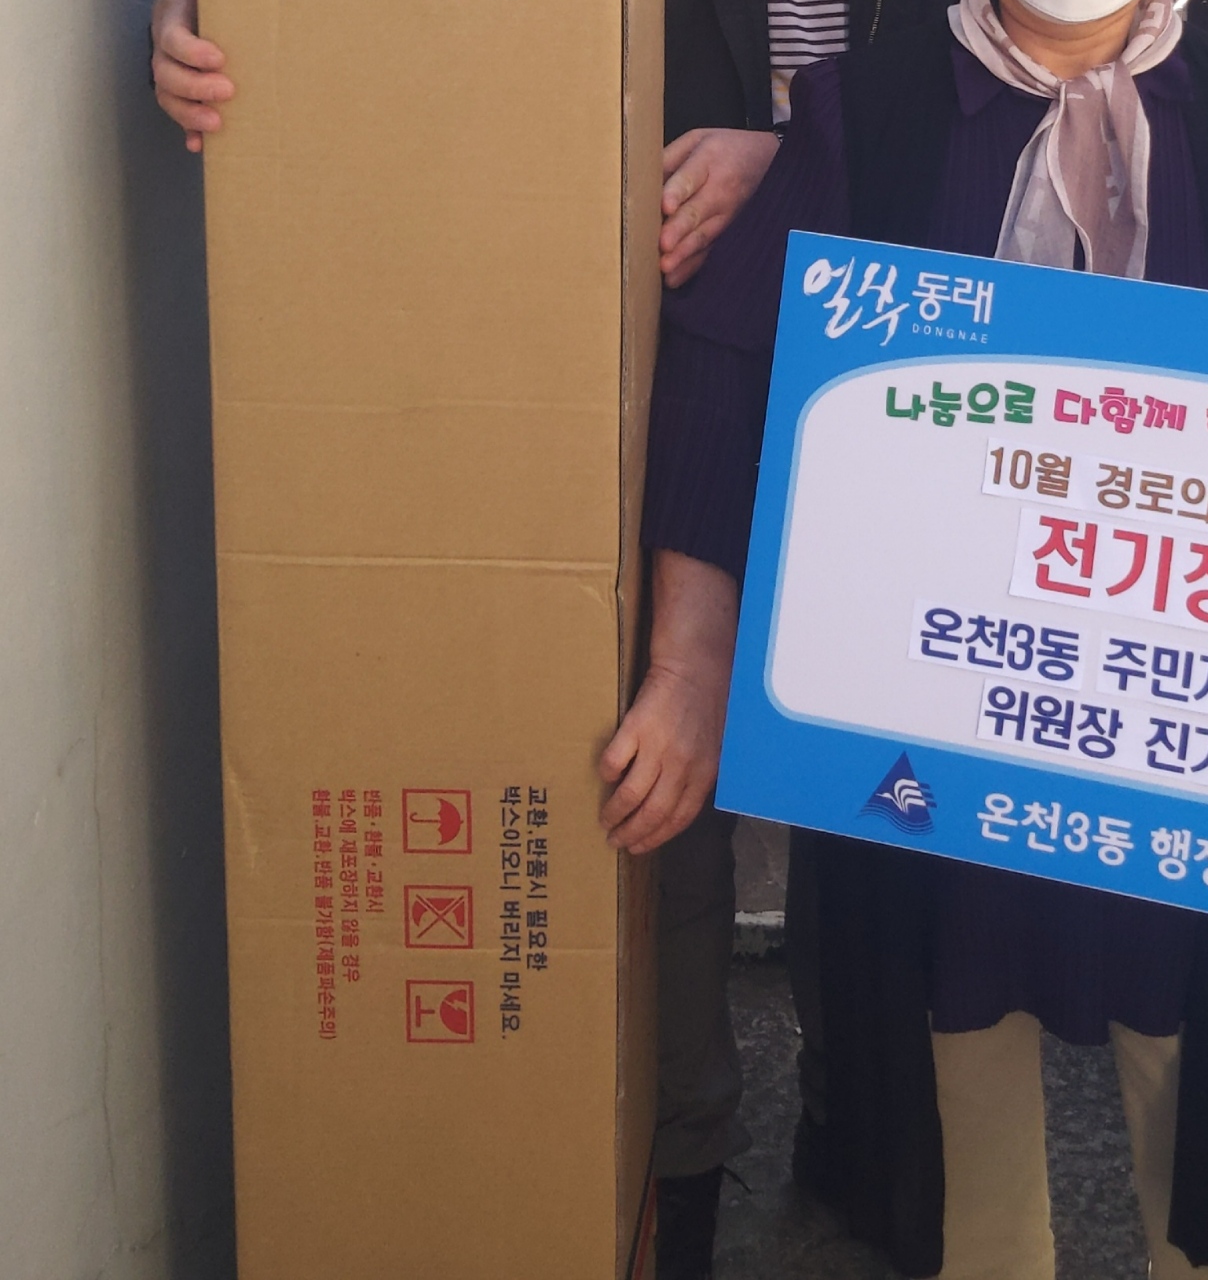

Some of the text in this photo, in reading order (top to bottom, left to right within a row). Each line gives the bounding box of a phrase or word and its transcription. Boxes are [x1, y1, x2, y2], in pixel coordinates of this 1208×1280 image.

[911, 271, 995, 325] 동래
[911, 323, 989, 344] DONGNAE
[885, 380, 1036, 427] 나눔으로
[1053, 386, 1187, 435] 다함께
[988, 445, 1073, 499] 10월
[919, 607, 1081, 683] 온천3동
[983, 685, 1124, 761] 위원장
[976, 792, 1135, 867] 온천3동
[338, 789, 361, 983] 박스에 재포장하지 않을 경우
[499, 786, 522, 1040] 박스이오니 버리지 마세요.
[527, 909, 548, 971] 필요한
